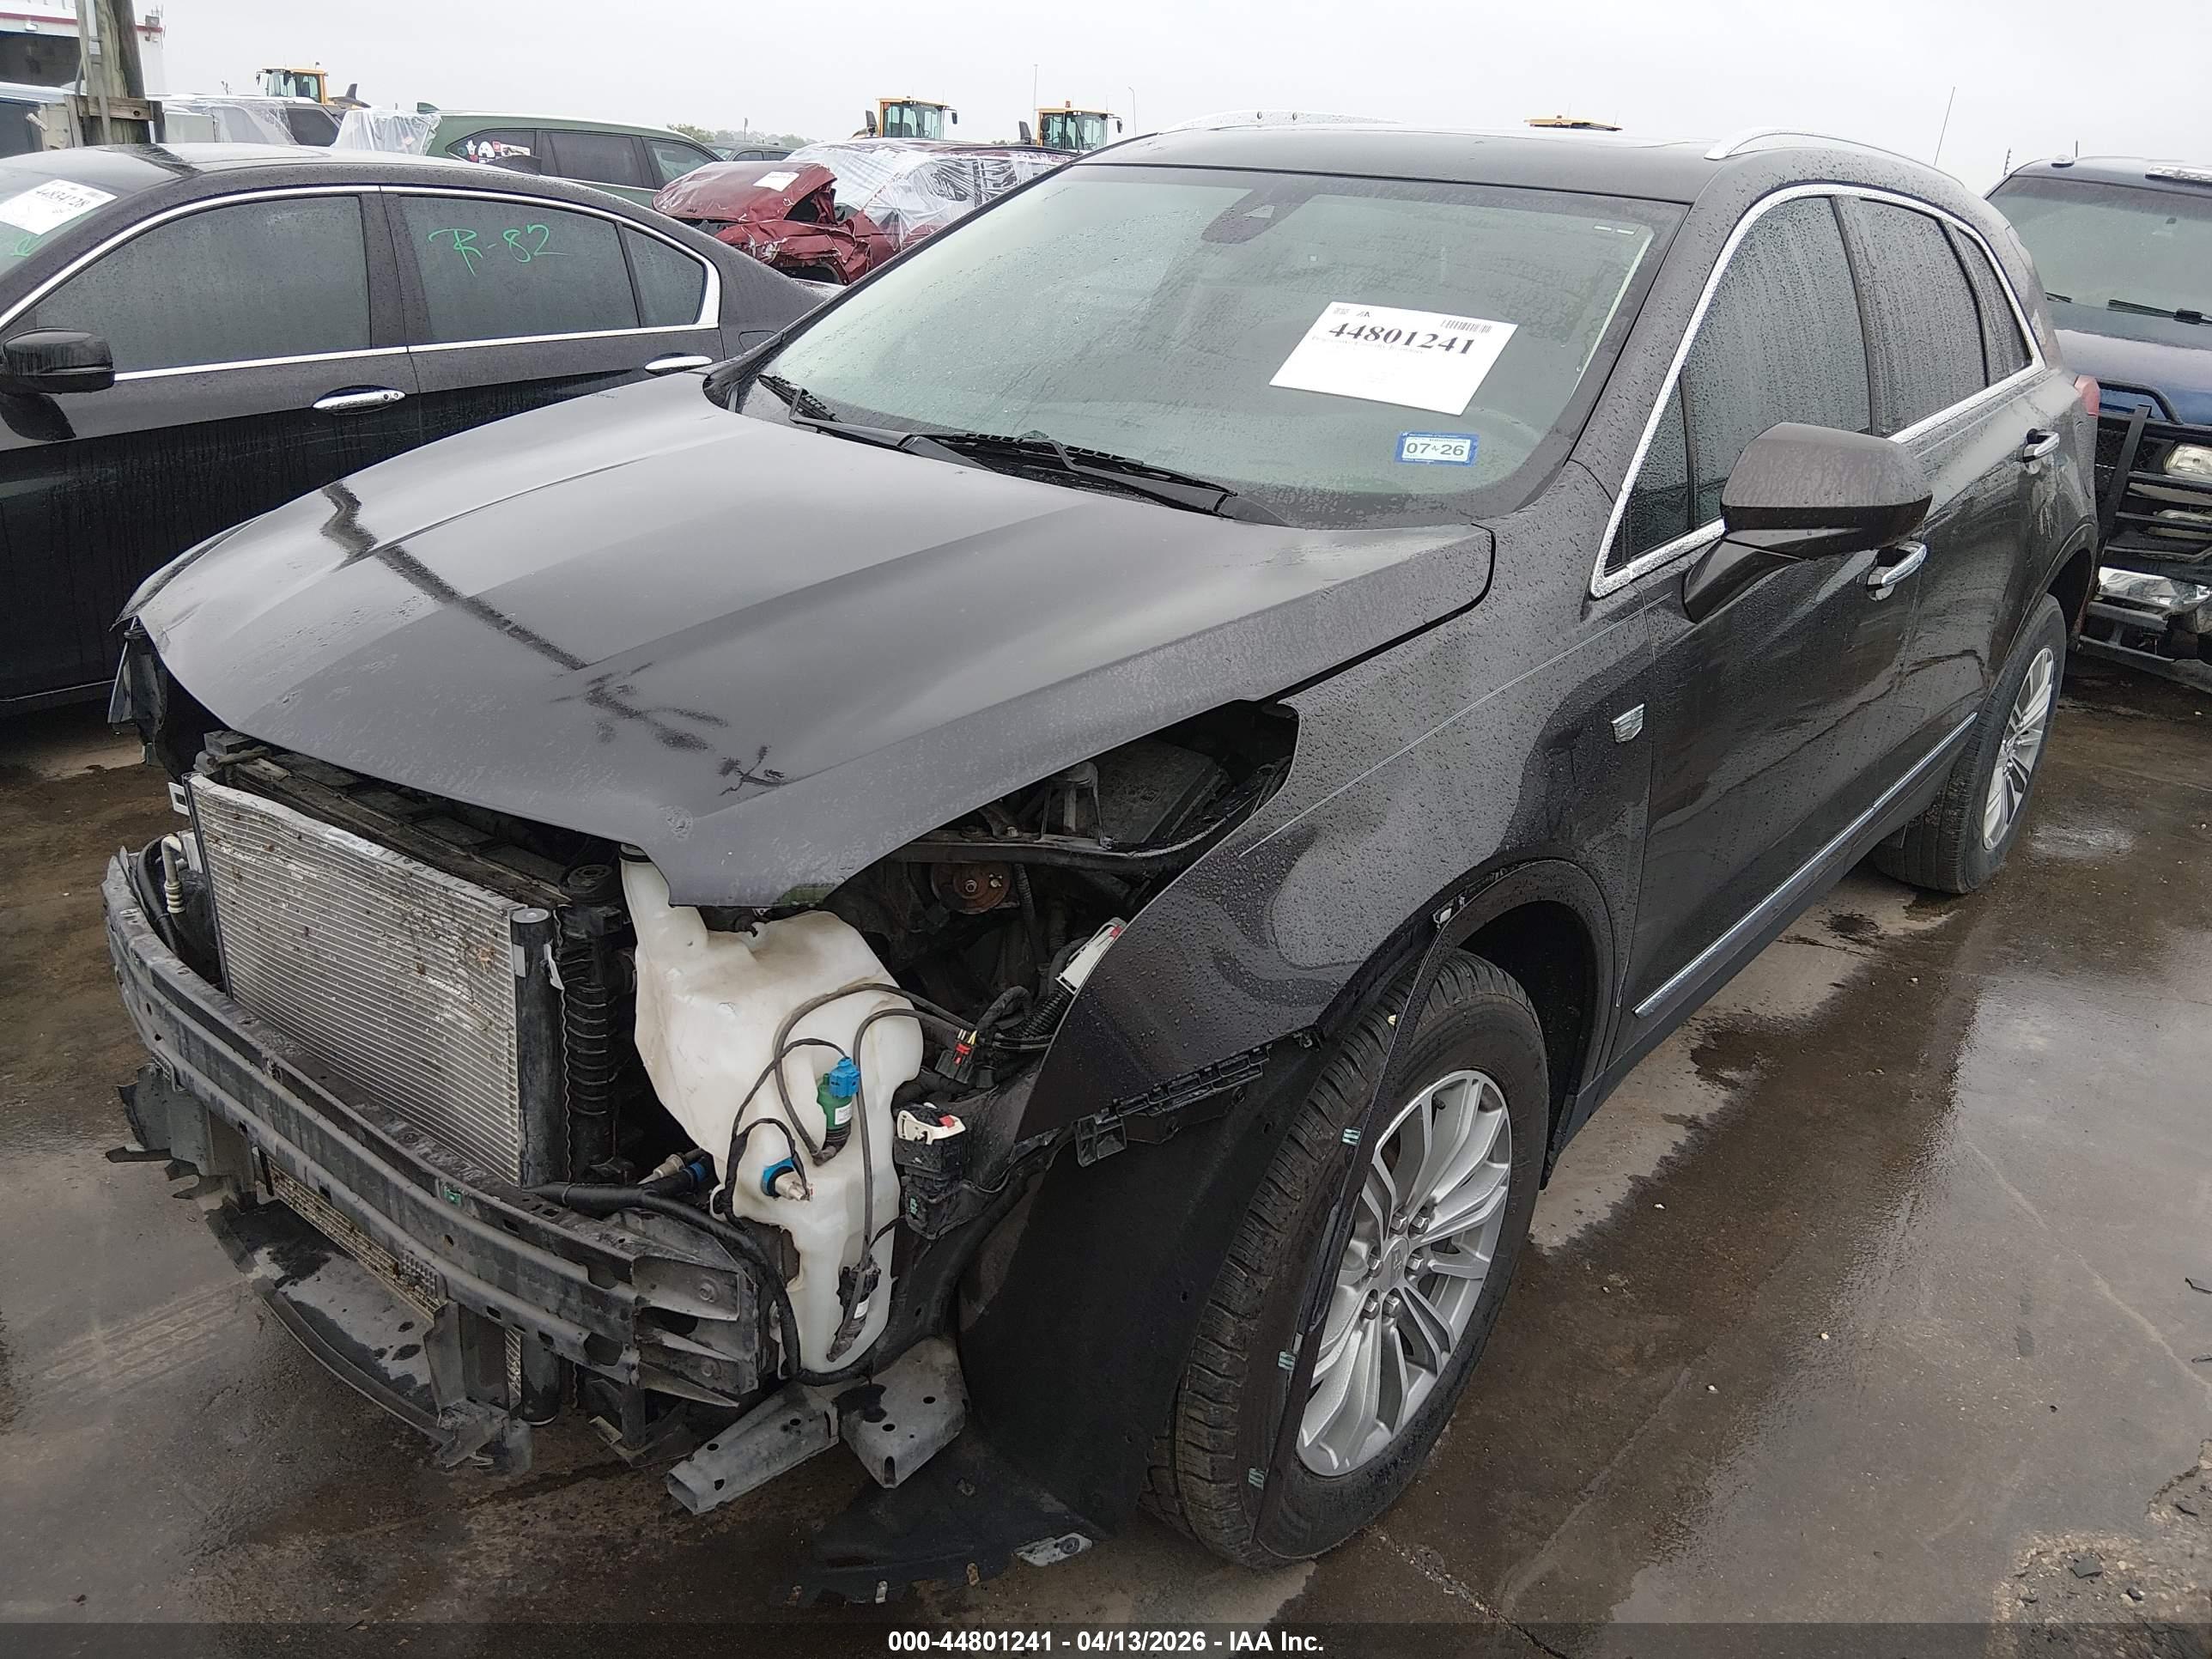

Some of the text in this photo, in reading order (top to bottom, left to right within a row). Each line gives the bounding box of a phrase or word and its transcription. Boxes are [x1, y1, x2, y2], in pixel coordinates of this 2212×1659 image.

[1328, 322, 1475, 355] 44801241
[1407, 442, 1464, 456] 07 26
